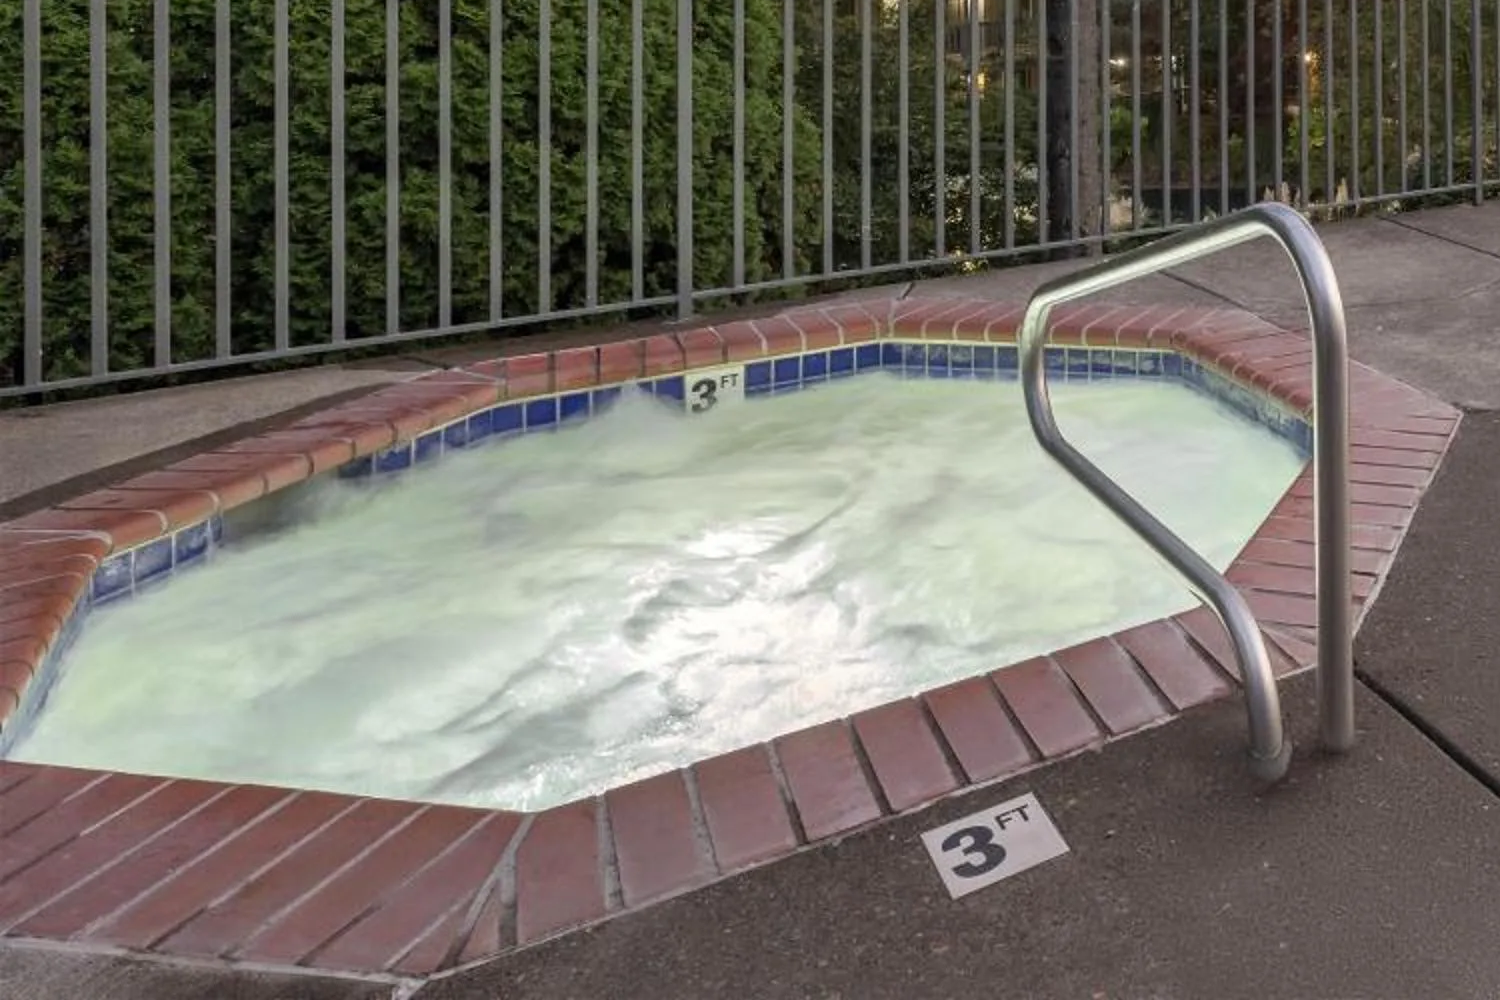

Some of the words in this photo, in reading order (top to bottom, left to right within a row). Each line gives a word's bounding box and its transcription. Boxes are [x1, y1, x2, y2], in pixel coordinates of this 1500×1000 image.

[691, 378, 718, 412] 3
[720, 373, 738, 389] FT
[941, 825, 1007, 879] 3
[995, 803, 1030, 831] FT
